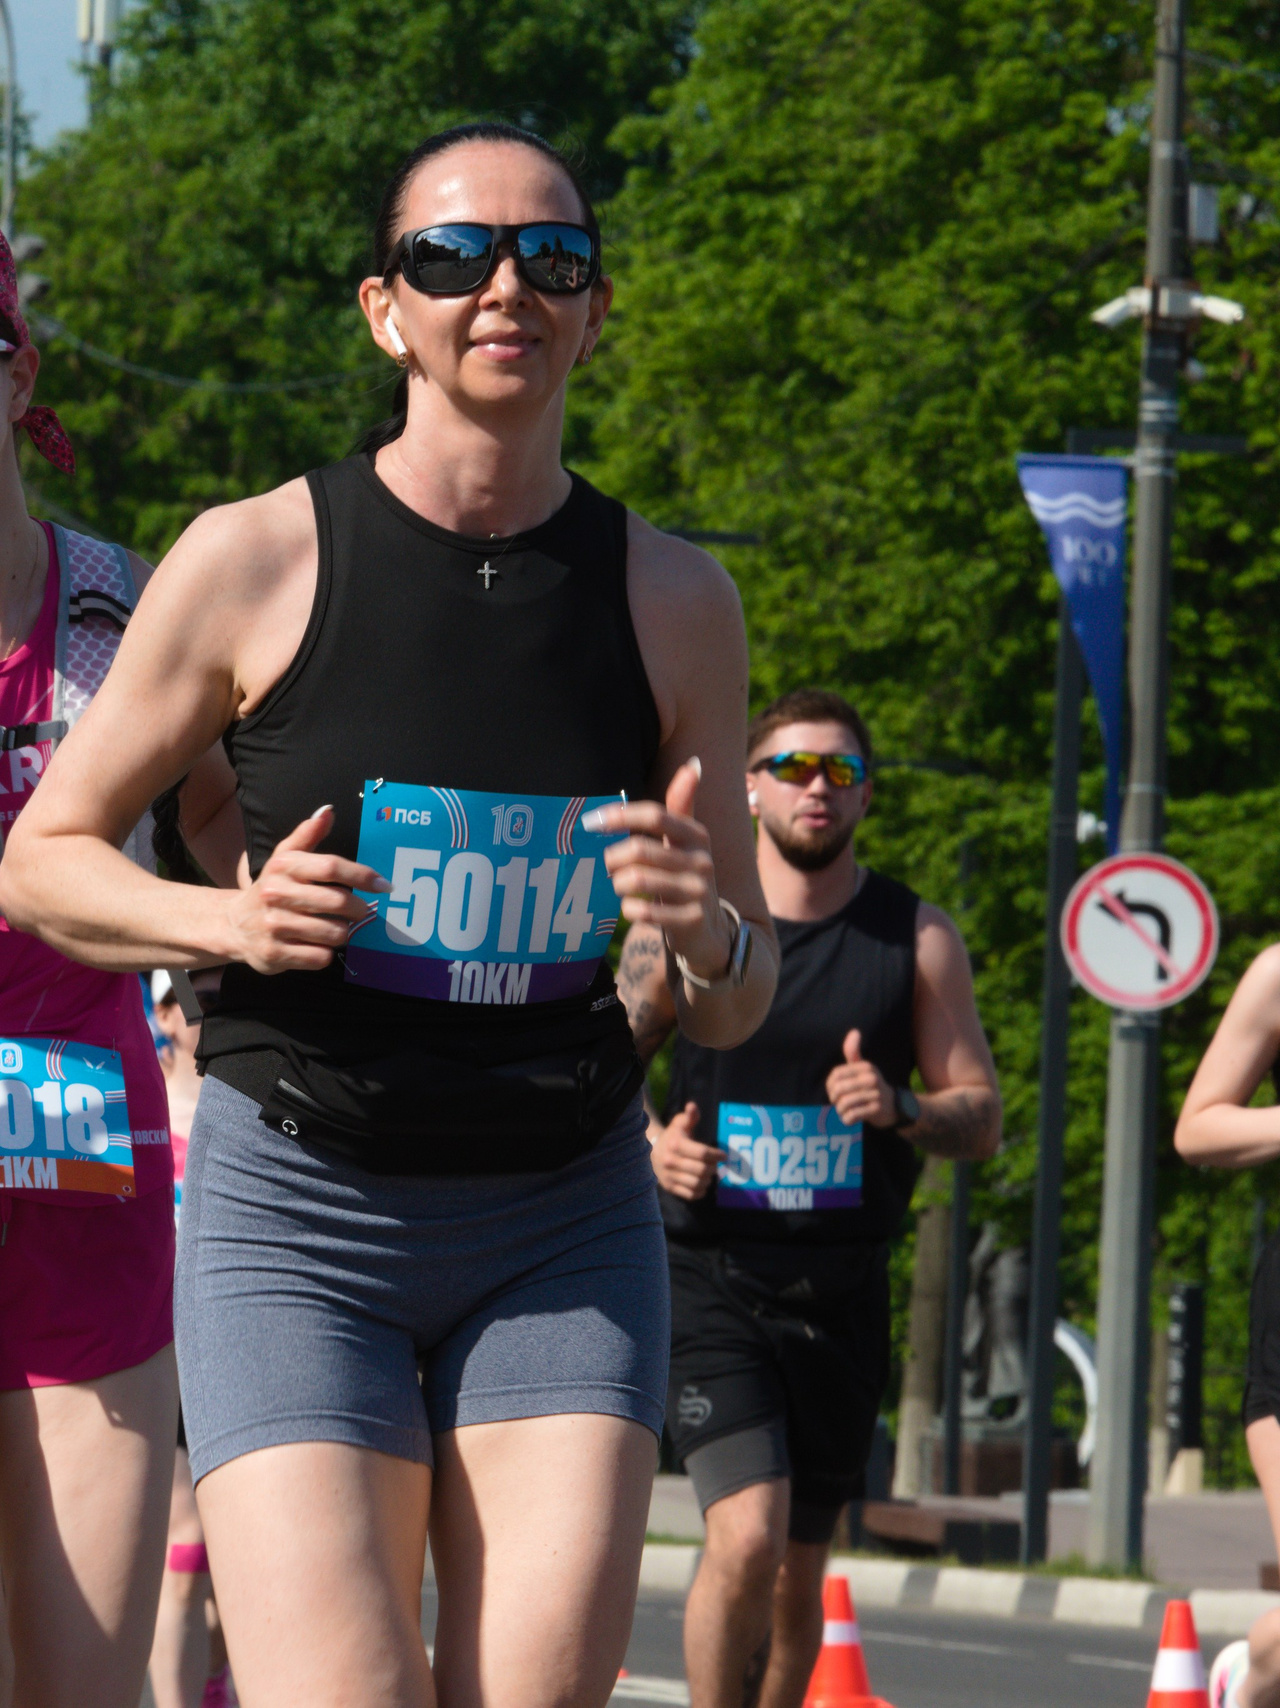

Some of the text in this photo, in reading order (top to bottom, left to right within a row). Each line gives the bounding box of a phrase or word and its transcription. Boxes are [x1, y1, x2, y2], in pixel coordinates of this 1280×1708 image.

[394, 808, 431, 826] ПСБ
[491, 804, 534, 846] 10
[385, 847, 596, 953] 50114
[447, 959, 533, 1005] 10KM
[727, 1134, 852, 1185] 50257
[767, 1187, 813, 1211] 10KM
